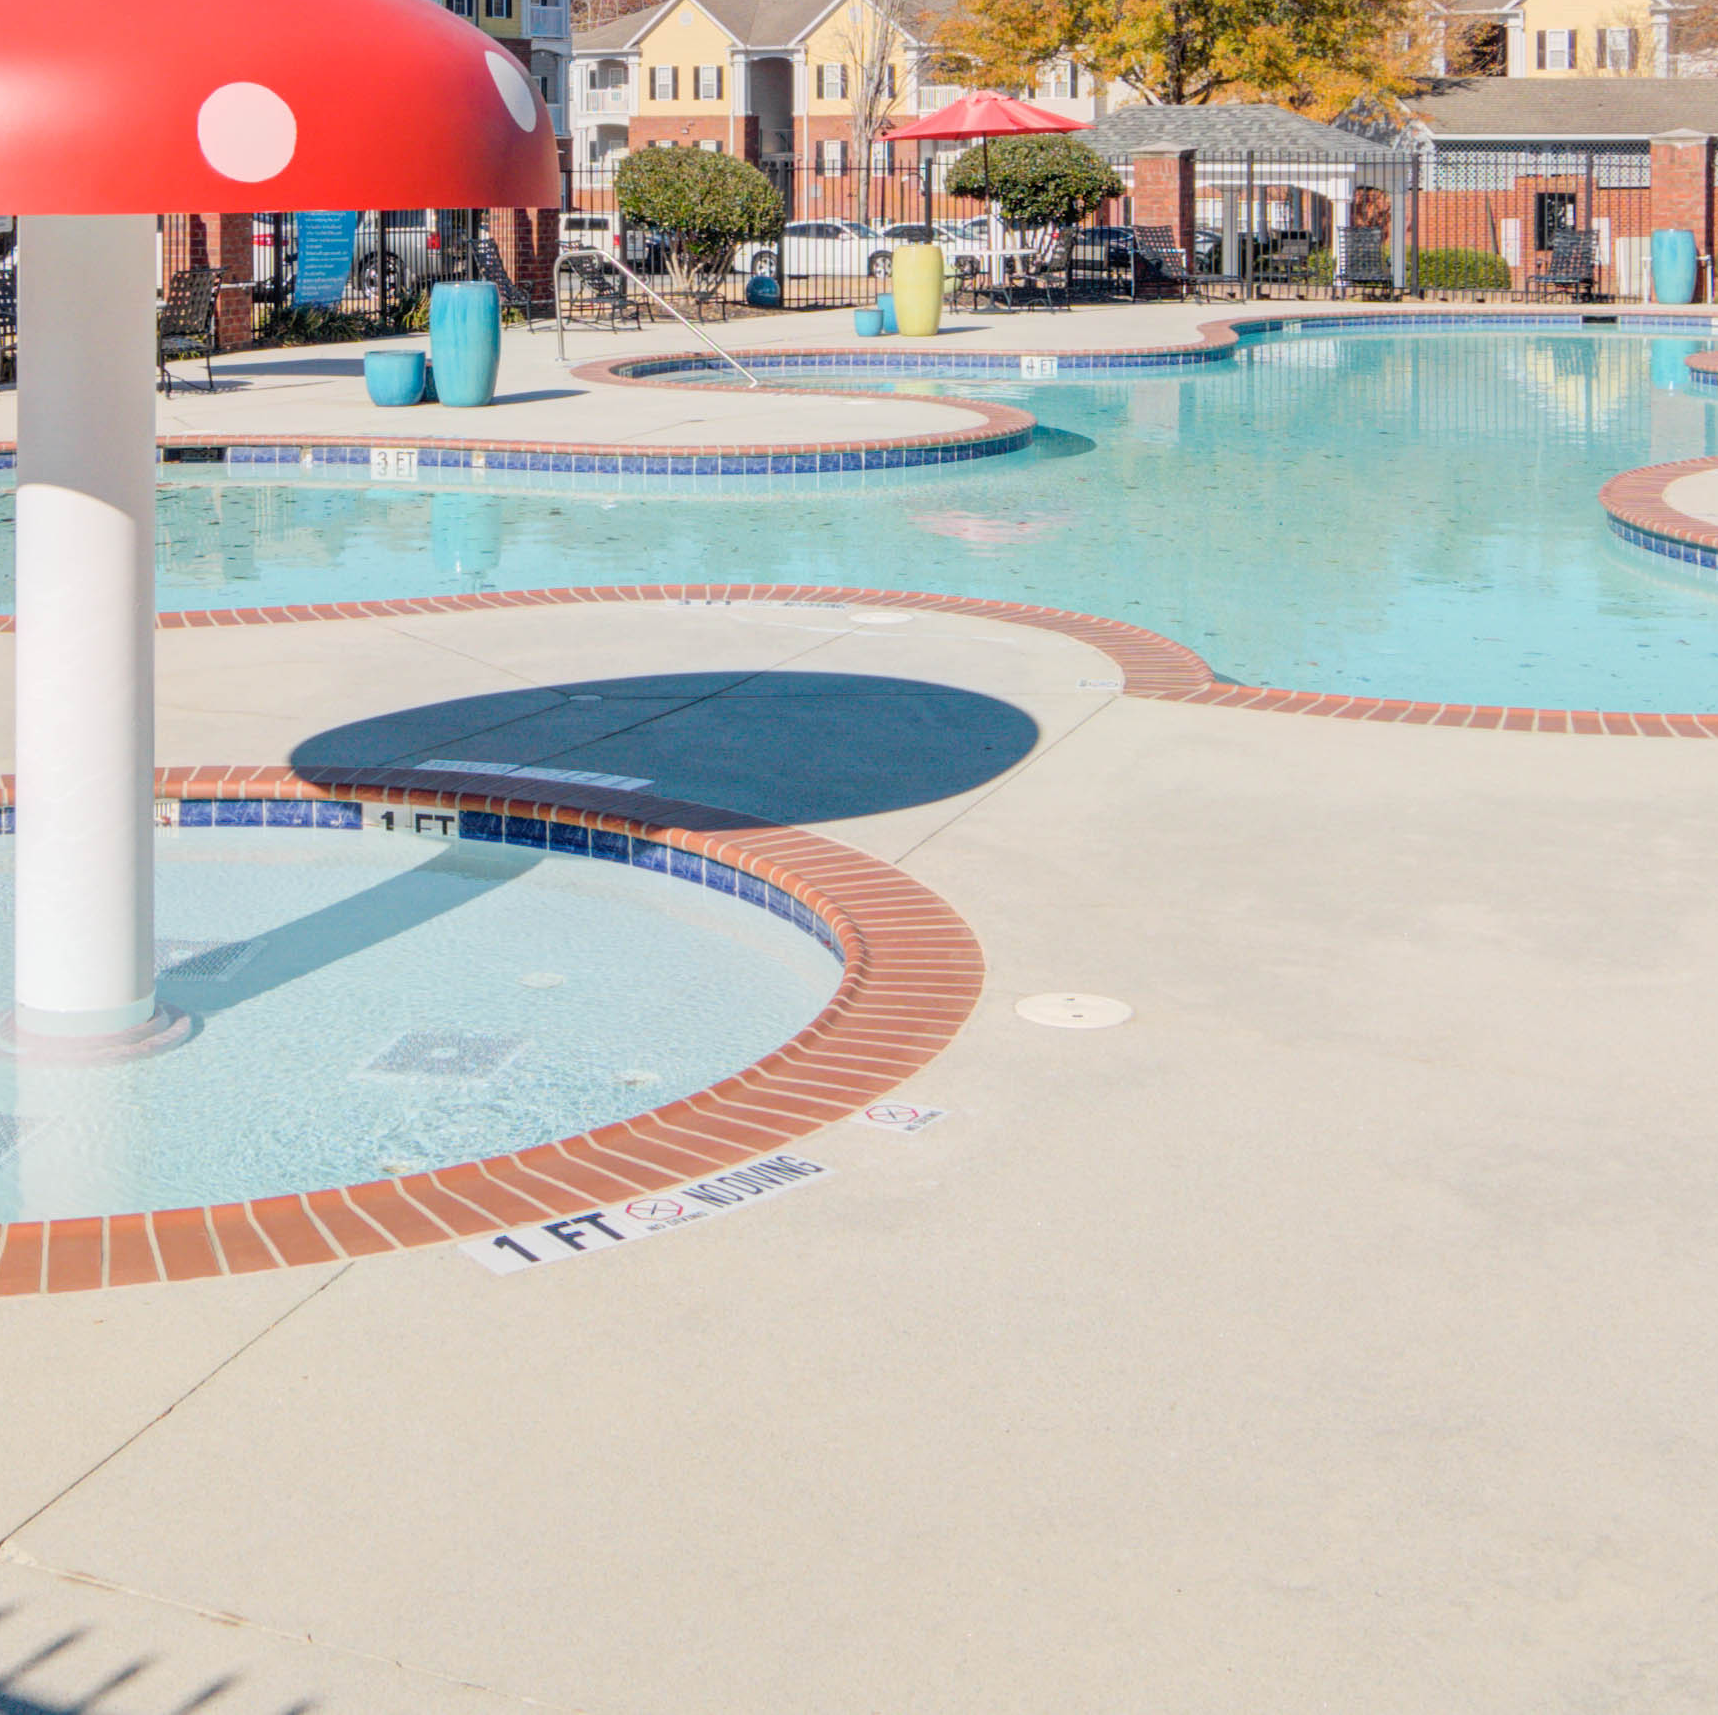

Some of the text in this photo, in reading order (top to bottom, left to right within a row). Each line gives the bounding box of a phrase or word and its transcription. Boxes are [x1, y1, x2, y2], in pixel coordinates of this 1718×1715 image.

[380, 811, 456, 836] 1 FT
[680, 1154, 825, 1209] NO DIVING
[492, 1211, 628, 1263] 1 FT
[645, 1210, 711, 1232] NO DIVING
